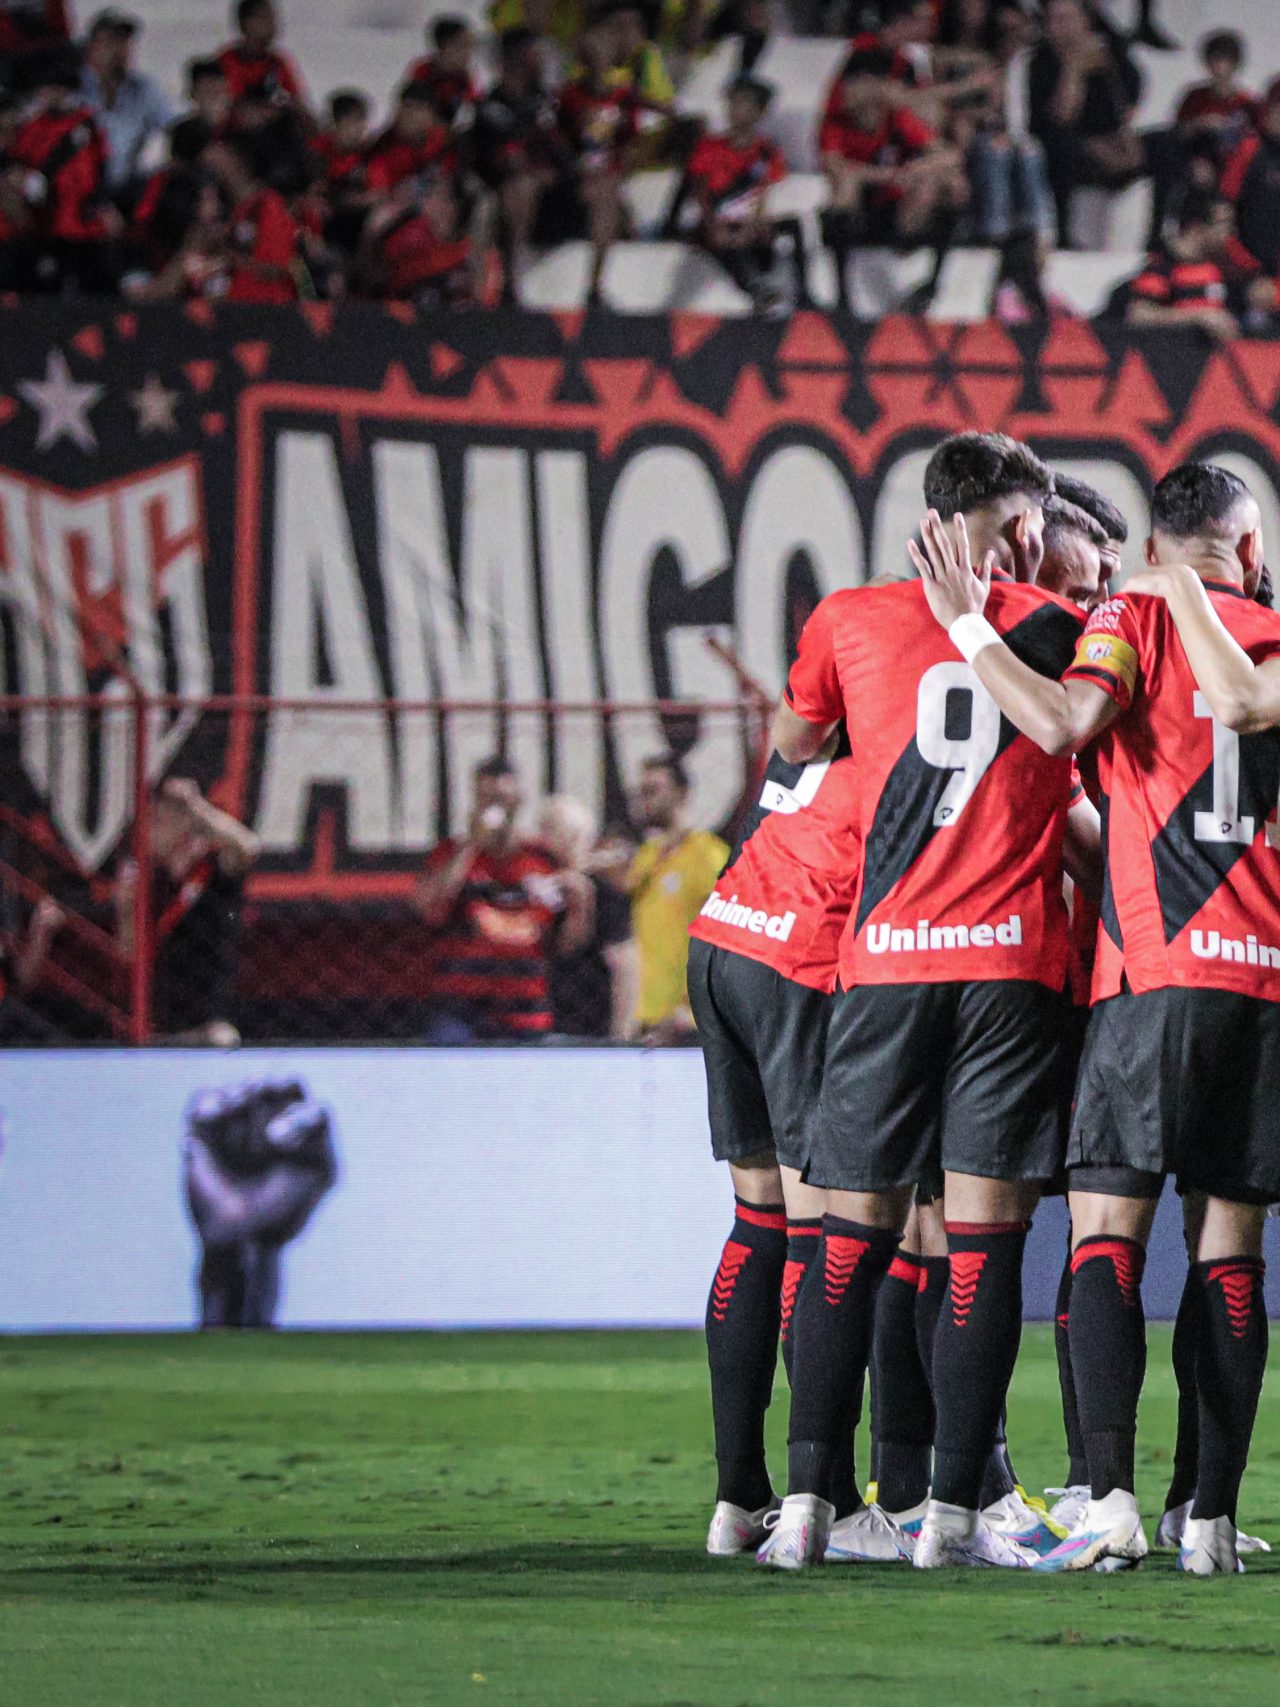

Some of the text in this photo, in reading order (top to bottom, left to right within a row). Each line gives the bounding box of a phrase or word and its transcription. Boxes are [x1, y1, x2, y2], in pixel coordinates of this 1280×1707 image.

[257, 431, 938, 855] AMIGO
[916, 661, 1000, 826] 9
[866, 915, 1022, 954] Unimed
